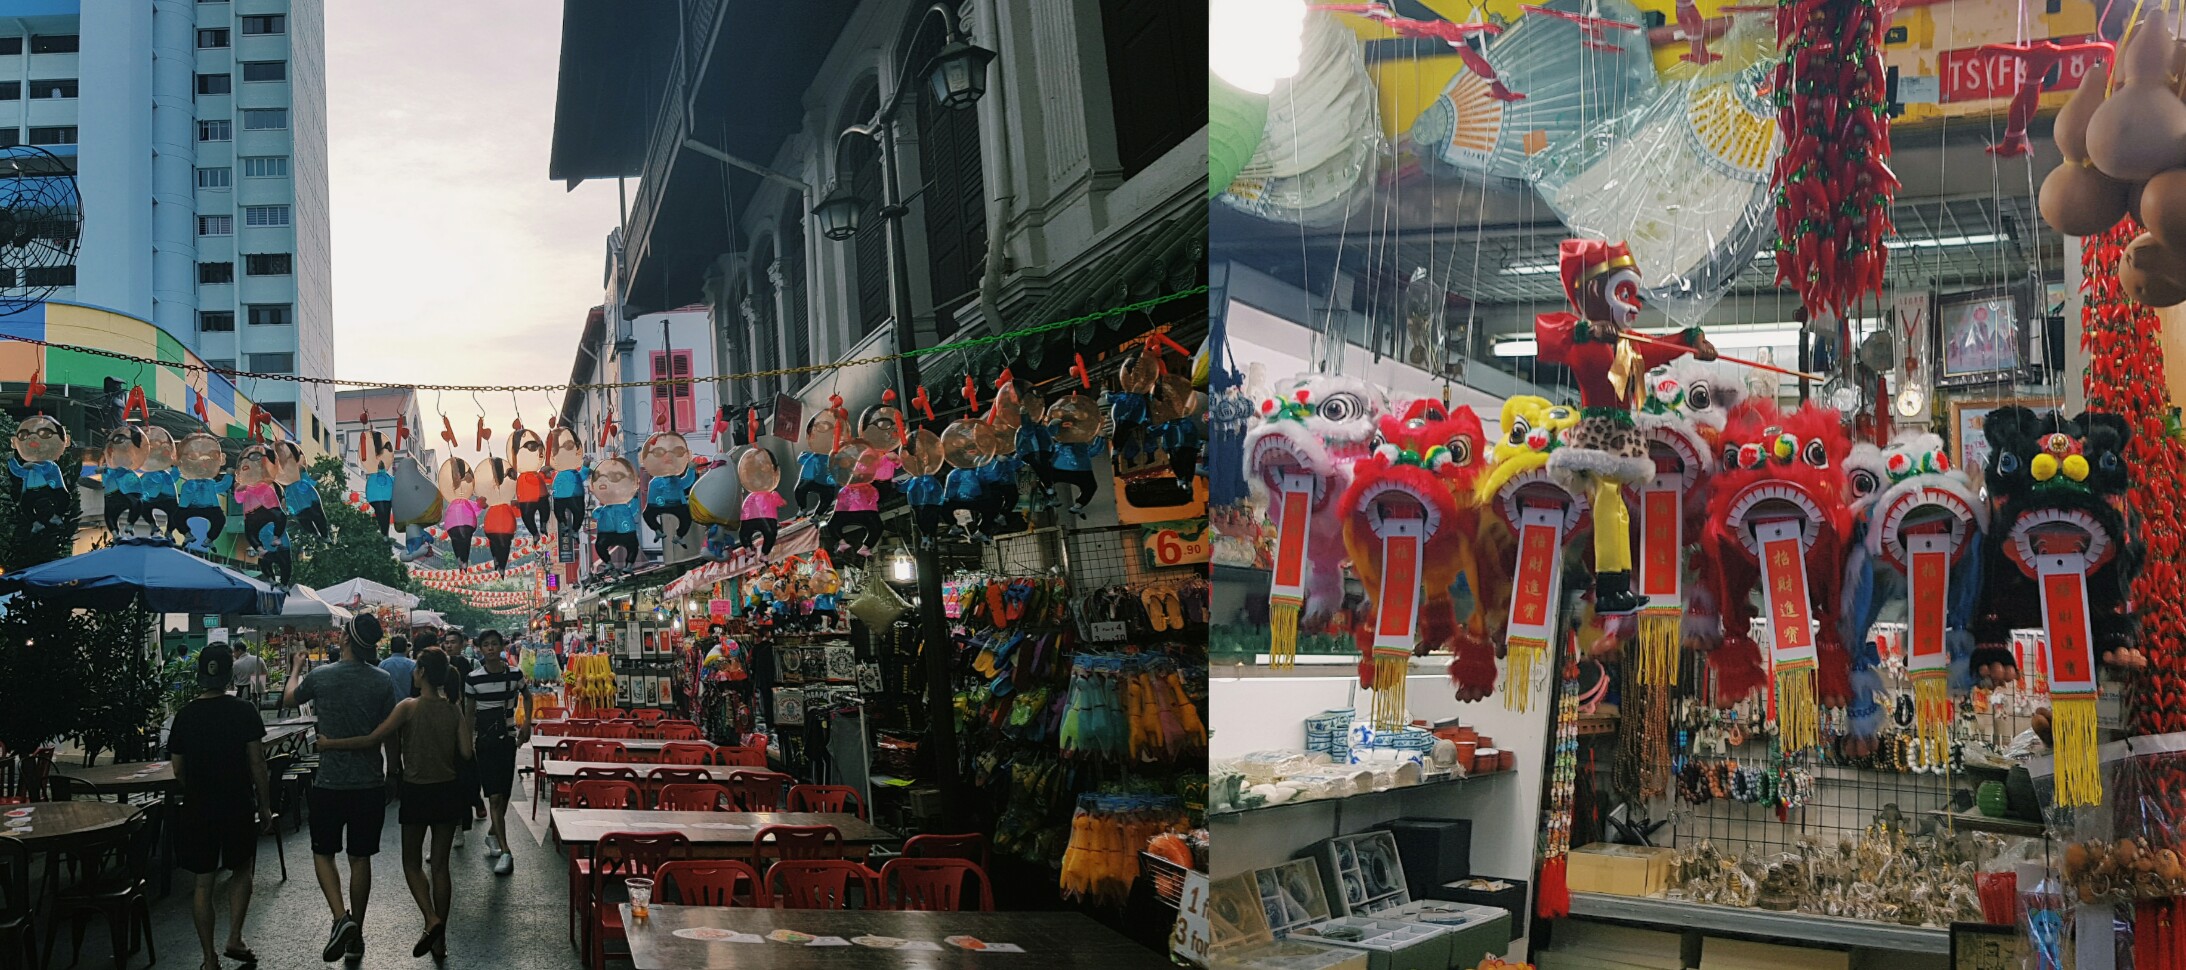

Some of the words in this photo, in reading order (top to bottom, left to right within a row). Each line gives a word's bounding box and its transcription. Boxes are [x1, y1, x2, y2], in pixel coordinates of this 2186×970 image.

[1773, 549, 1800, 645] 招財進寶
[1187, 887, 1199, 914] 1
[1175, 917, 1188, 945] 3
